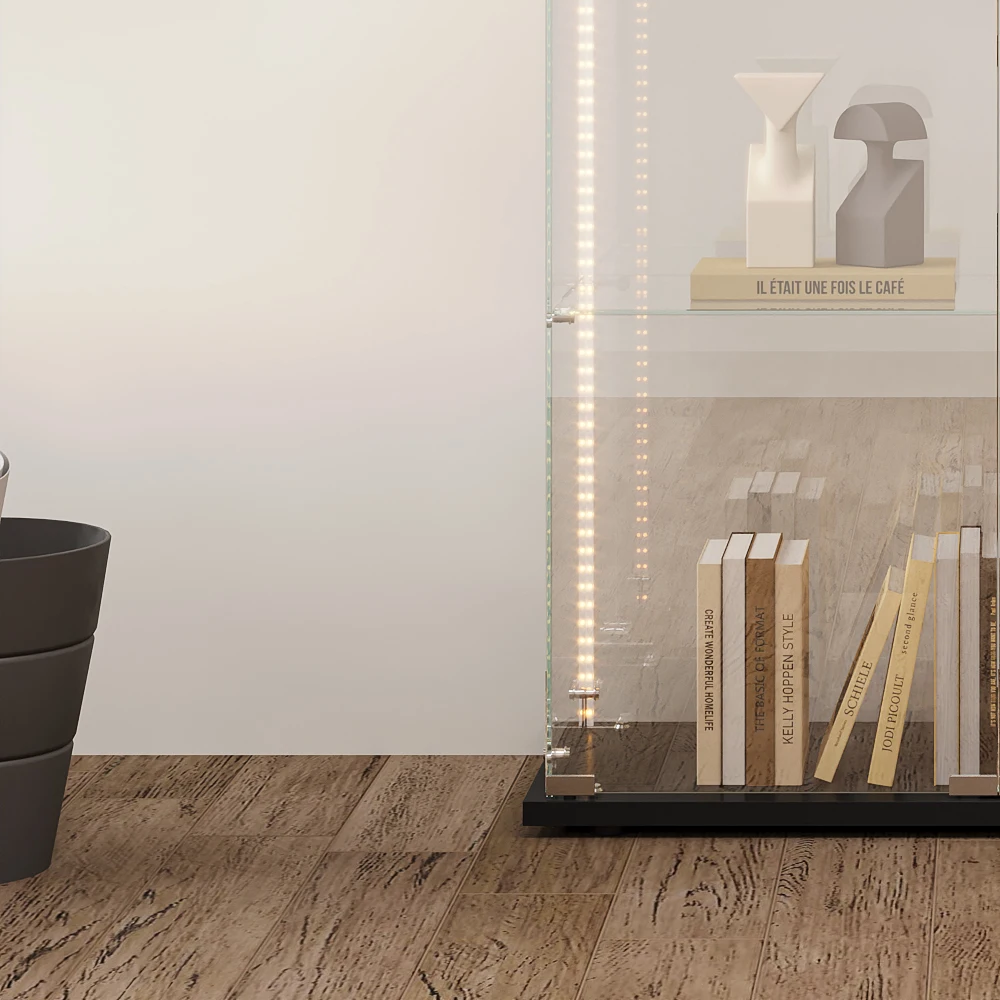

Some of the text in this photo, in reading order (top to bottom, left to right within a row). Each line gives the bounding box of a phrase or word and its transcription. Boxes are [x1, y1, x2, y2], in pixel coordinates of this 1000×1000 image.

[756, 277, 905, 295] IL ÉTAIT UNE FOIS LE CAFÉ
[901, 591, 918, 655] second glance
[704, 609, 714, 731] CREATE WONDERFUL HOMELIFE
[754, 606, 765, 733] THE BASIC OF FORMAT
[782, 613, 794, 745] KELLY HOPPEN STYLE
[844, 660, 873, 717] SCHIELE
[882, 673, 905, 753] JODI PICOULT
